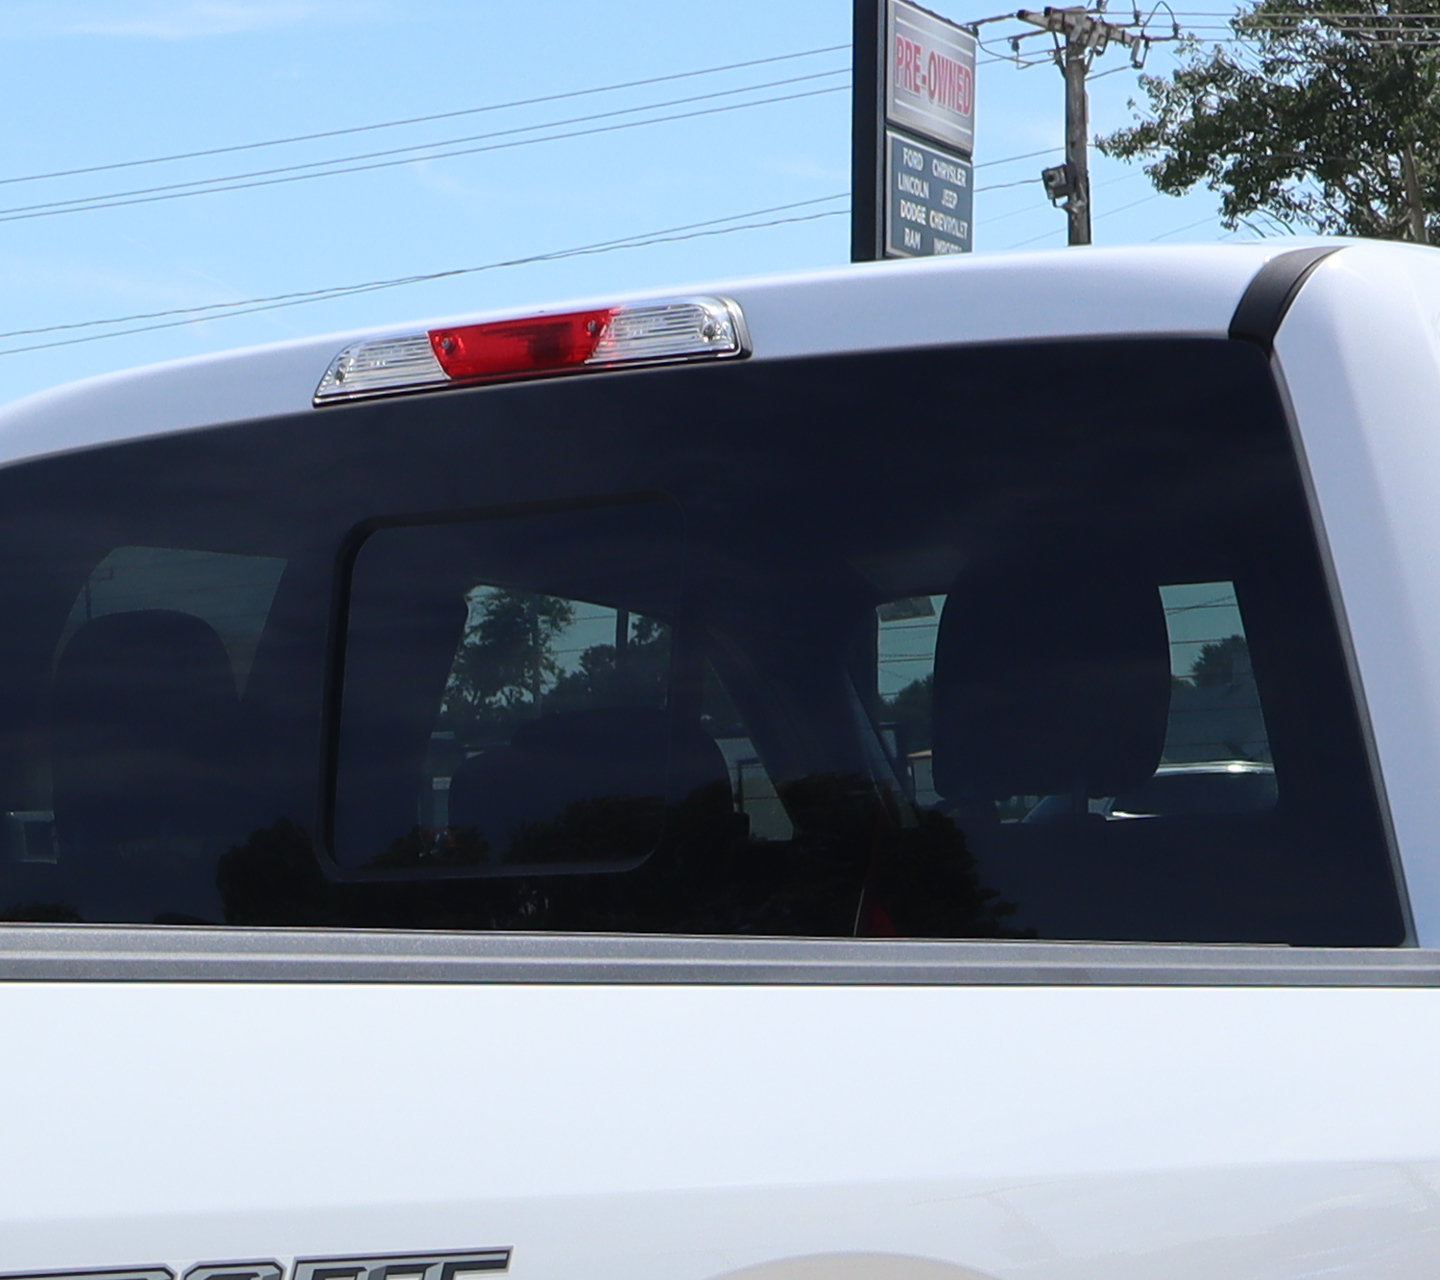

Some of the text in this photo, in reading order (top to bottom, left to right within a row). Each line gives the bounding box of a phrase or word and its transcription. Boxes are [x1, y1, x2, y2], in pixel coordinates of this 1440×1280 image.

[895, 36, 972, 115] PRE-OWNED
[903, 147, 924, 166] FORD
[932, 159, 967, 188] CHRYSLER
[897, 174, 929, 199] LINCOLN
[941, 189, 958, 209] JEEP
[900, 199, 926, 225] DODGE
[929, 211, 968, 239] CHEVROLET
[904, 228, 921, 249] RAM
